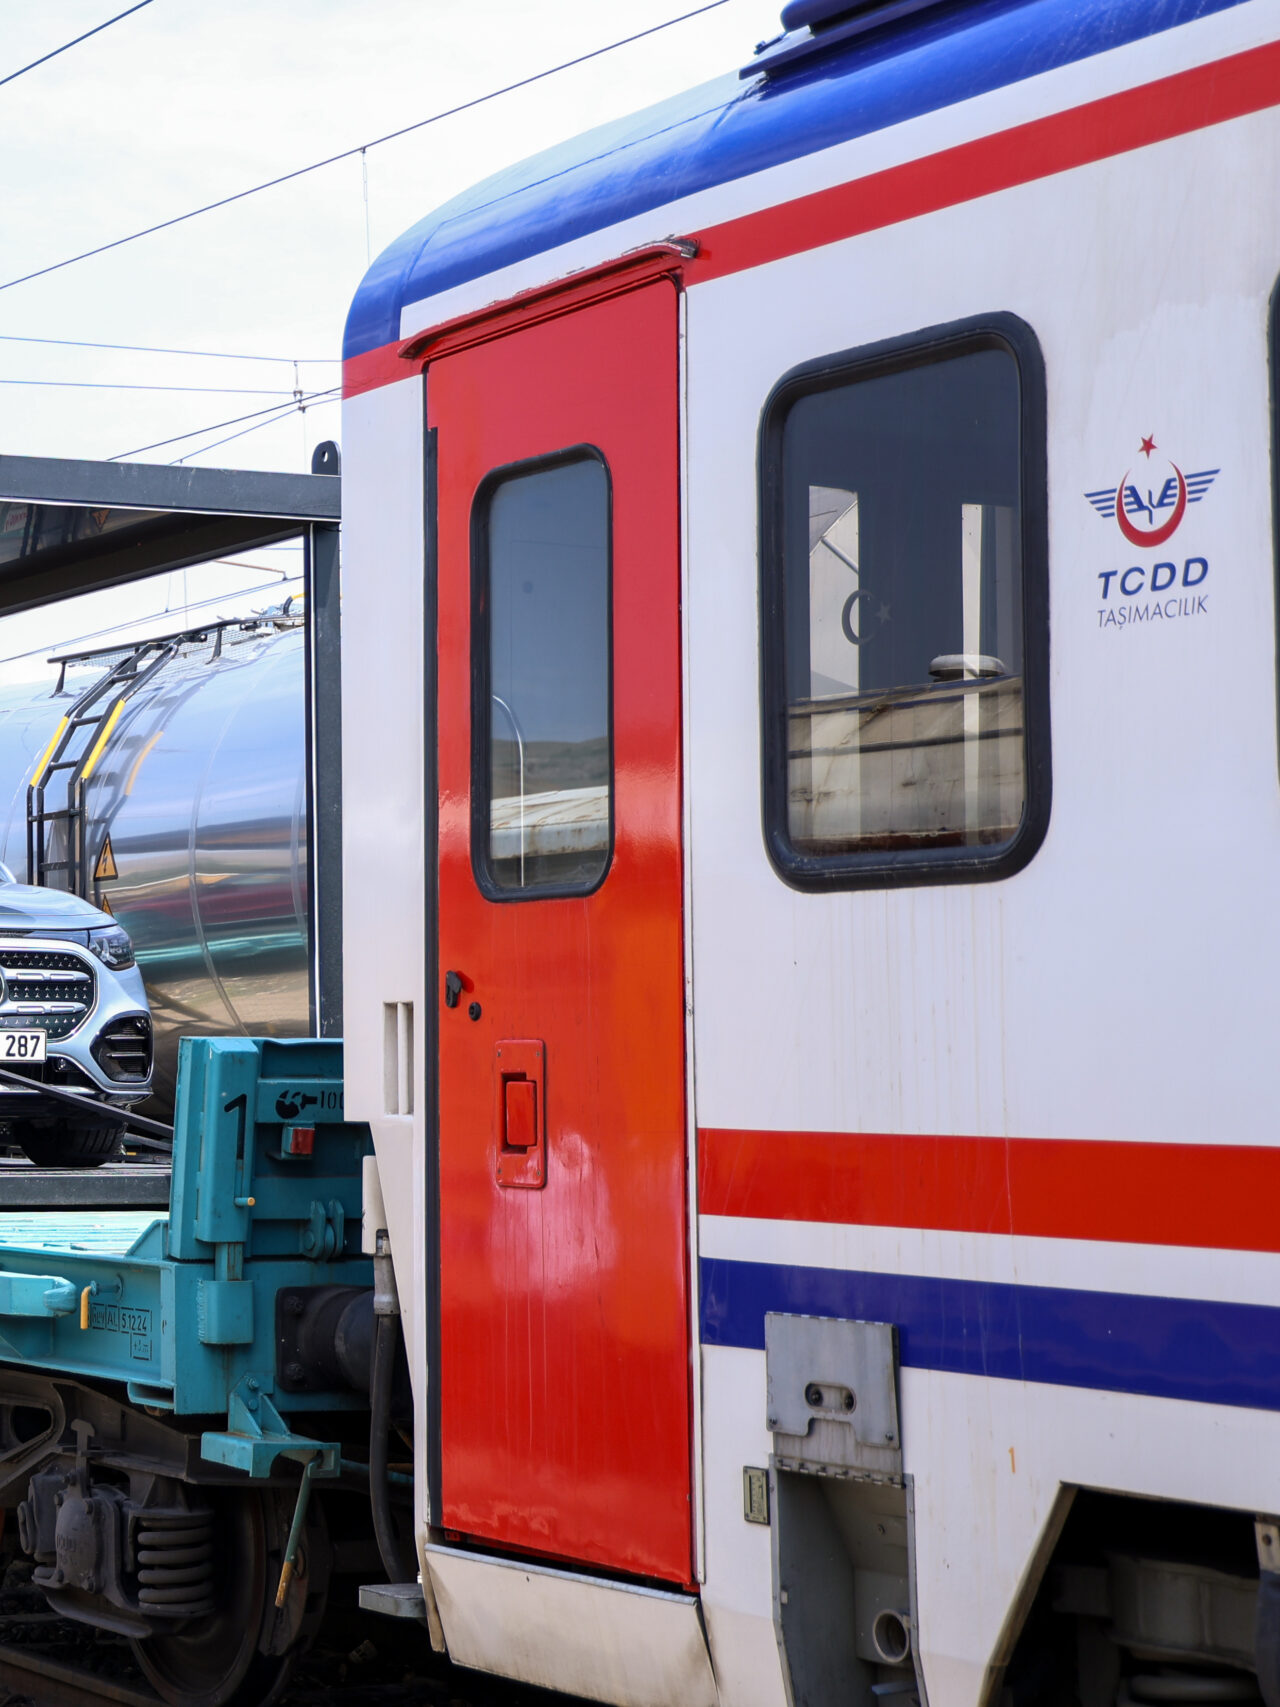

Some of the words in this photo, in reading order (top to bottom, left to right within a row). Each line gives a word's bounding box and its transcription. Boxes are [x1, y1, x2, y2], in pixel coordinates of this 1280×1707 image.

[1097, 556, 1209, 600] TCDD
[1097, 594, 1209, 630] TAŞIMACILIK
[5, 1034, 41, 1057] 287
[224, 1093, 247, 1160] 1
